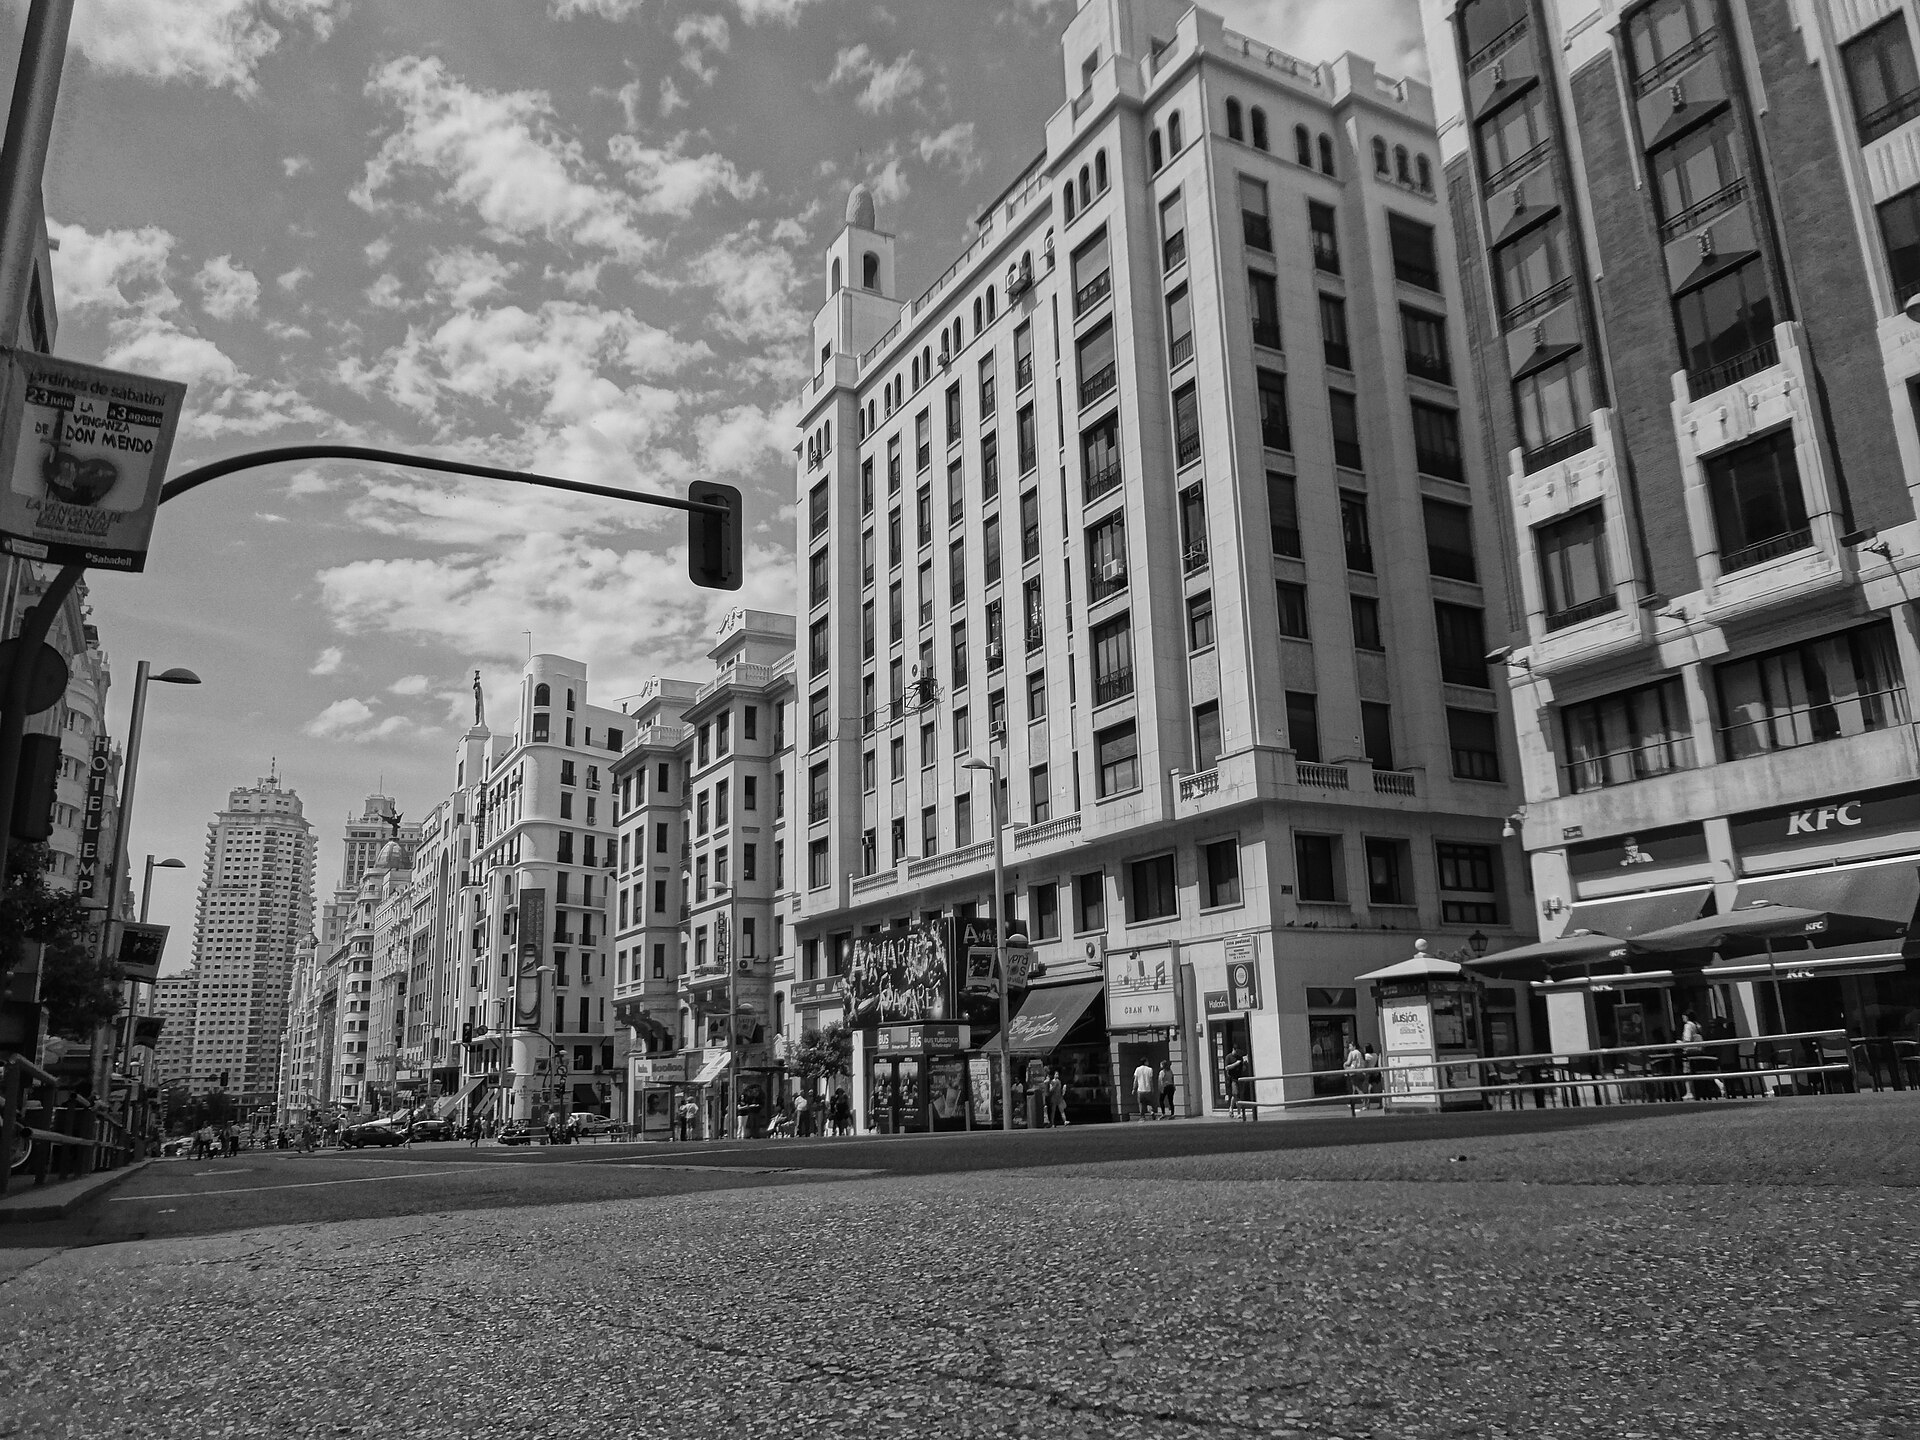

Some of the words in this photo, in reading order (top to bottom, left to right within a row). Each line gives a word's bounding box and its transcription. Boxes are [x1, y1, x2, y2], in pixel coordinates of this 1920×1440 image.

[90, 381, 108, 395] de
[27, 387, 49, 404] 23
[80, 402, 93, 412] LA
[117, 406, 127, 420] 3
[73, 413, 130, 434] VENGANZA
[65, 424, 96, 444] DON
[102, 431, 153, 453] MENDO
[91, 553, 132, 567] Sabadell
[86, 736, 109, 830] HOTEL
[1786, 800, 1862, 836] KFC
[717, 911, 726, 953] HOSTAL
[1805, 921, 1824, 931] KFC
[1124, 1005, 1142, 1015] GRAN
[1148, 1004, 1160, 1013] VIA
[910, 1036, 921, 1048] BUS
